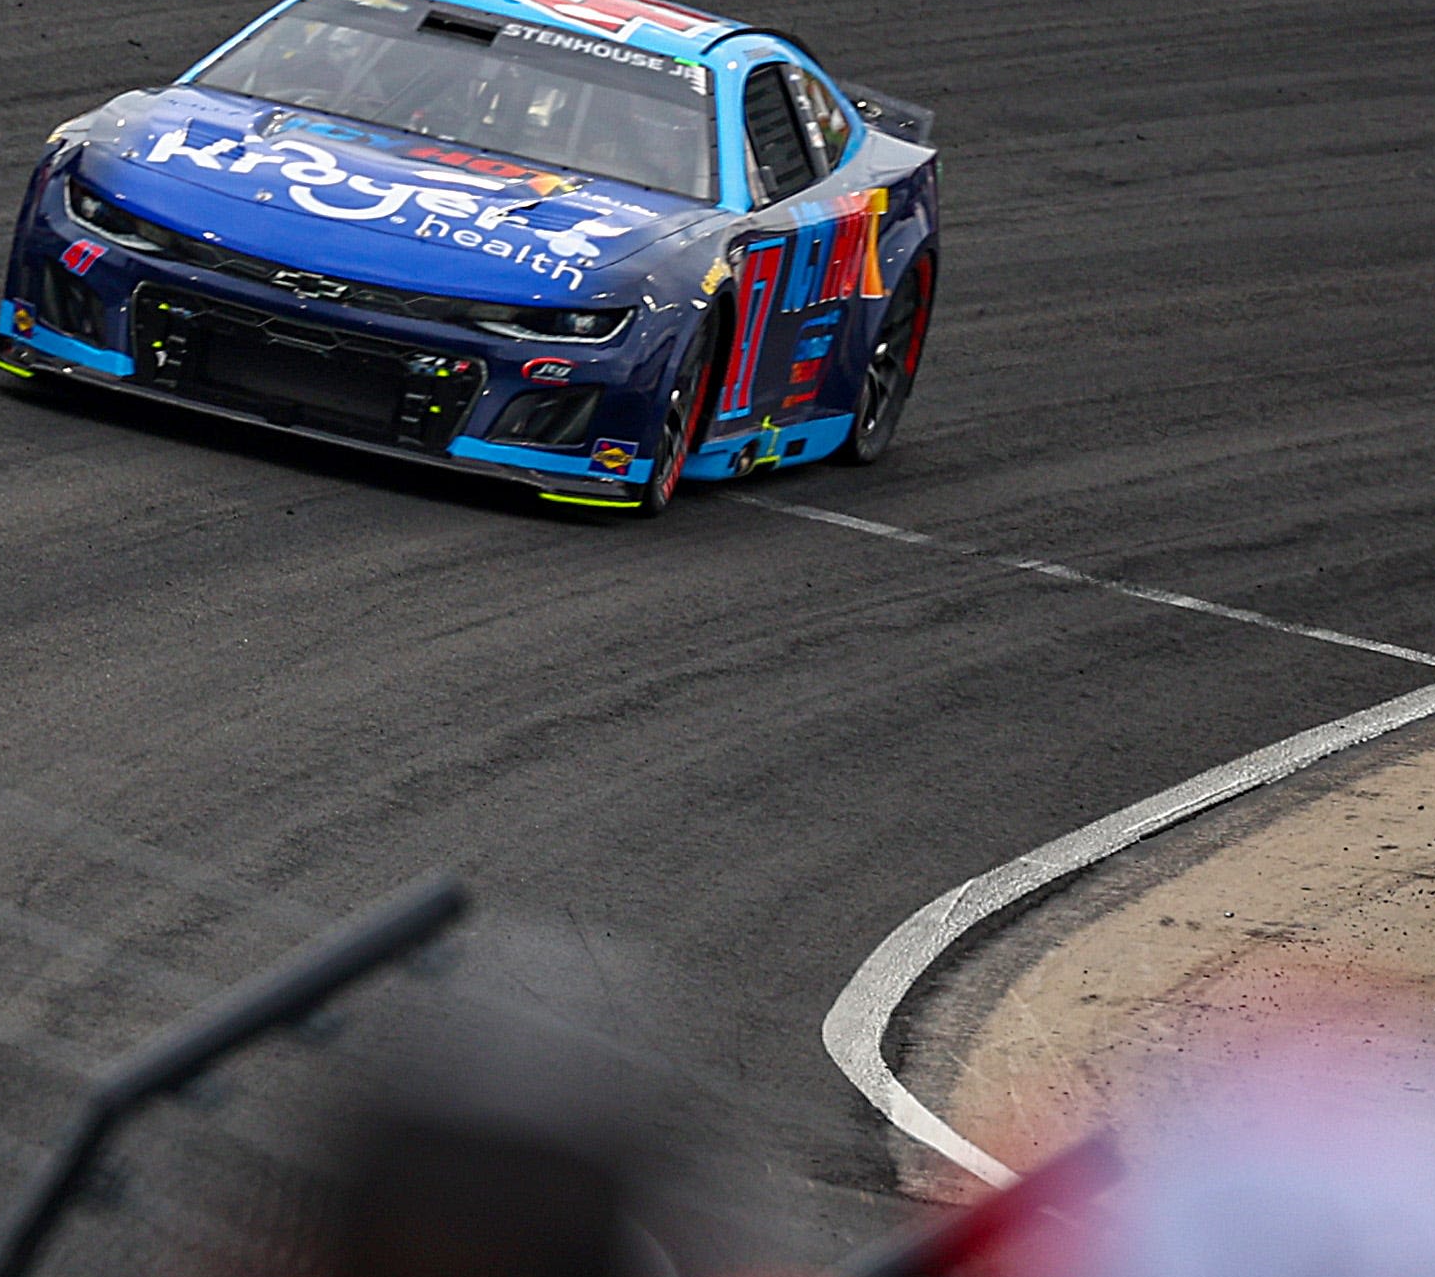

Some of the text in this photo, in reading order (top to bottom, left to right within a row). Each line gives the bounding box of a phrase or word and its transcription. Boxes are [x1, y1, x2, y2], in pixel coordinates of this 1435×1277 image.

[502, 23, 665, 72] STENHOUSE
[59, 238, 109, 276] 47
[415, 212, 585, 291] health
